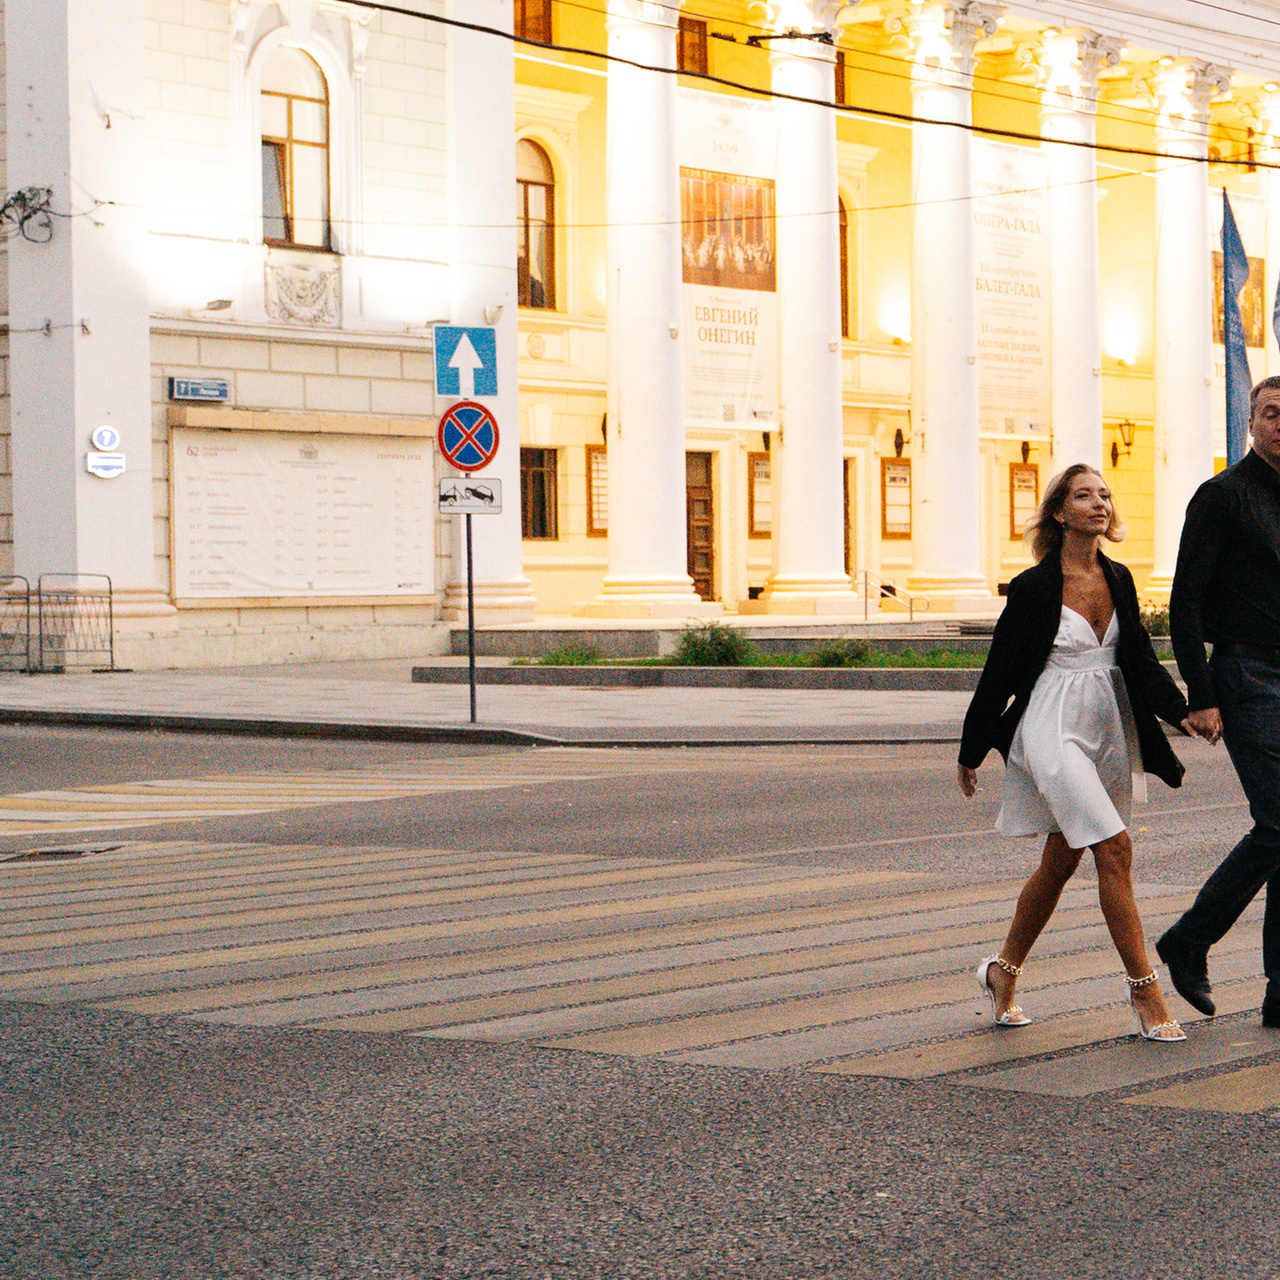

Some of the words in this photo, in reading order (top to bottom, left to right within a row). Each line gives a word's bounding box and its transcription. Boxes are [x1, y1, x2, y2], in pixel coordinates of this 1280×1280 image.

[974, 211, 1042, 235] ОПЕРА-ГАЛА
[975, 277, 1042, 298] БАЛЕТ-ГАЛА
[694, 305, 759, 326] ЕВГЕНИЙ
[697, 326, 757, 346] ОНЕГИН
[102, 431, 112, 445] 7
[186, 446, 199, 457] 62
